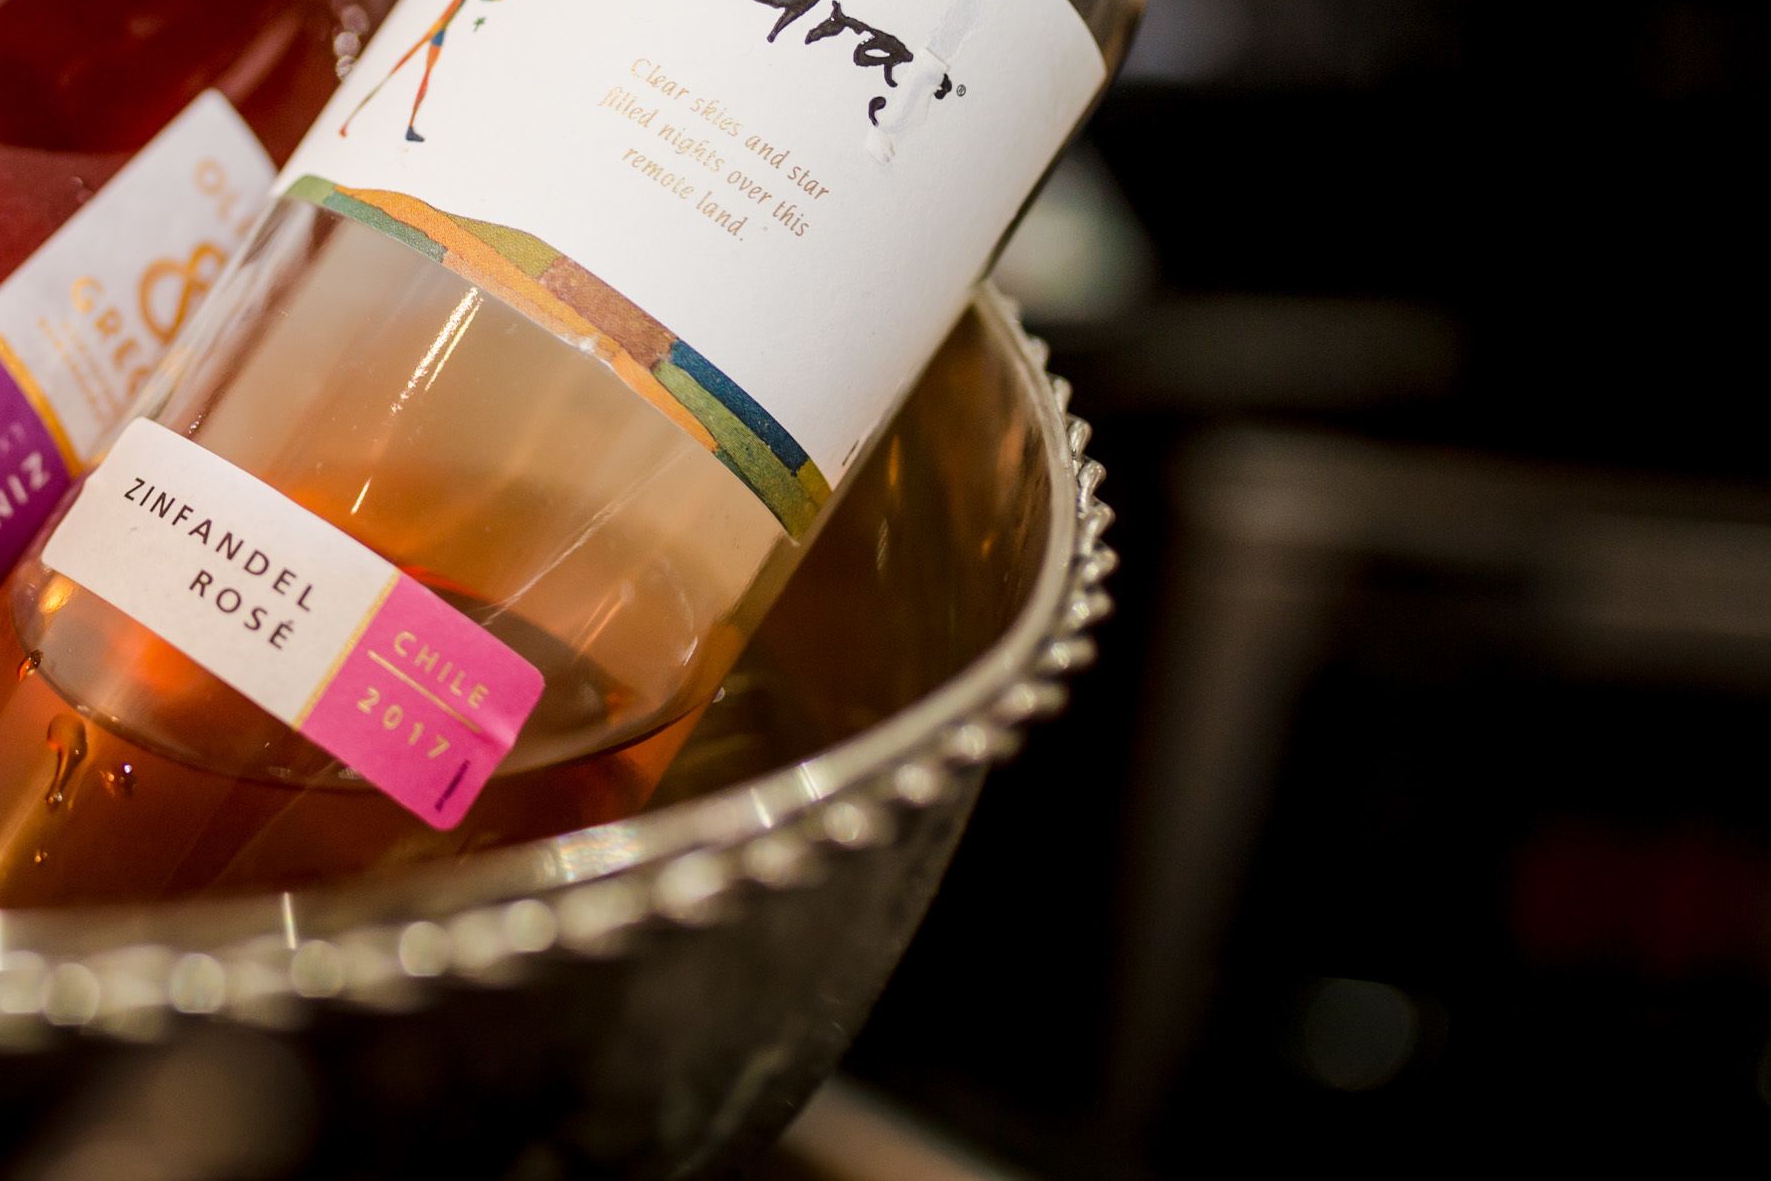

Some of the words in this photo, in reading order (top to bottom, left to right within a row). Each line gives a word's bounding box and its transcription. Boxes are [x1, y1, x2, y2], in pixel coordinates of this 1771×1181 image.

[597, 86, 659, 128] filled
[658, 123, 725, 172] nights
[726, 170, 772, 205] over
[772, 201, 810, 237] this
[631, 58, 690, 100] Clear
[690, 97, 742, 137] skies
[745, 135, 791, 169] and
[787, 166, 830, 200] star
[622, 148, 695, 200] remote
[696, 191, 749, 241] land.
[123, 477, 313, 612] ZINFANDEL
[188, 570, 296, 650] ROSÉ
[393, 630, 490, 709] CHILE
[357, 685, 451, 759] 2017
